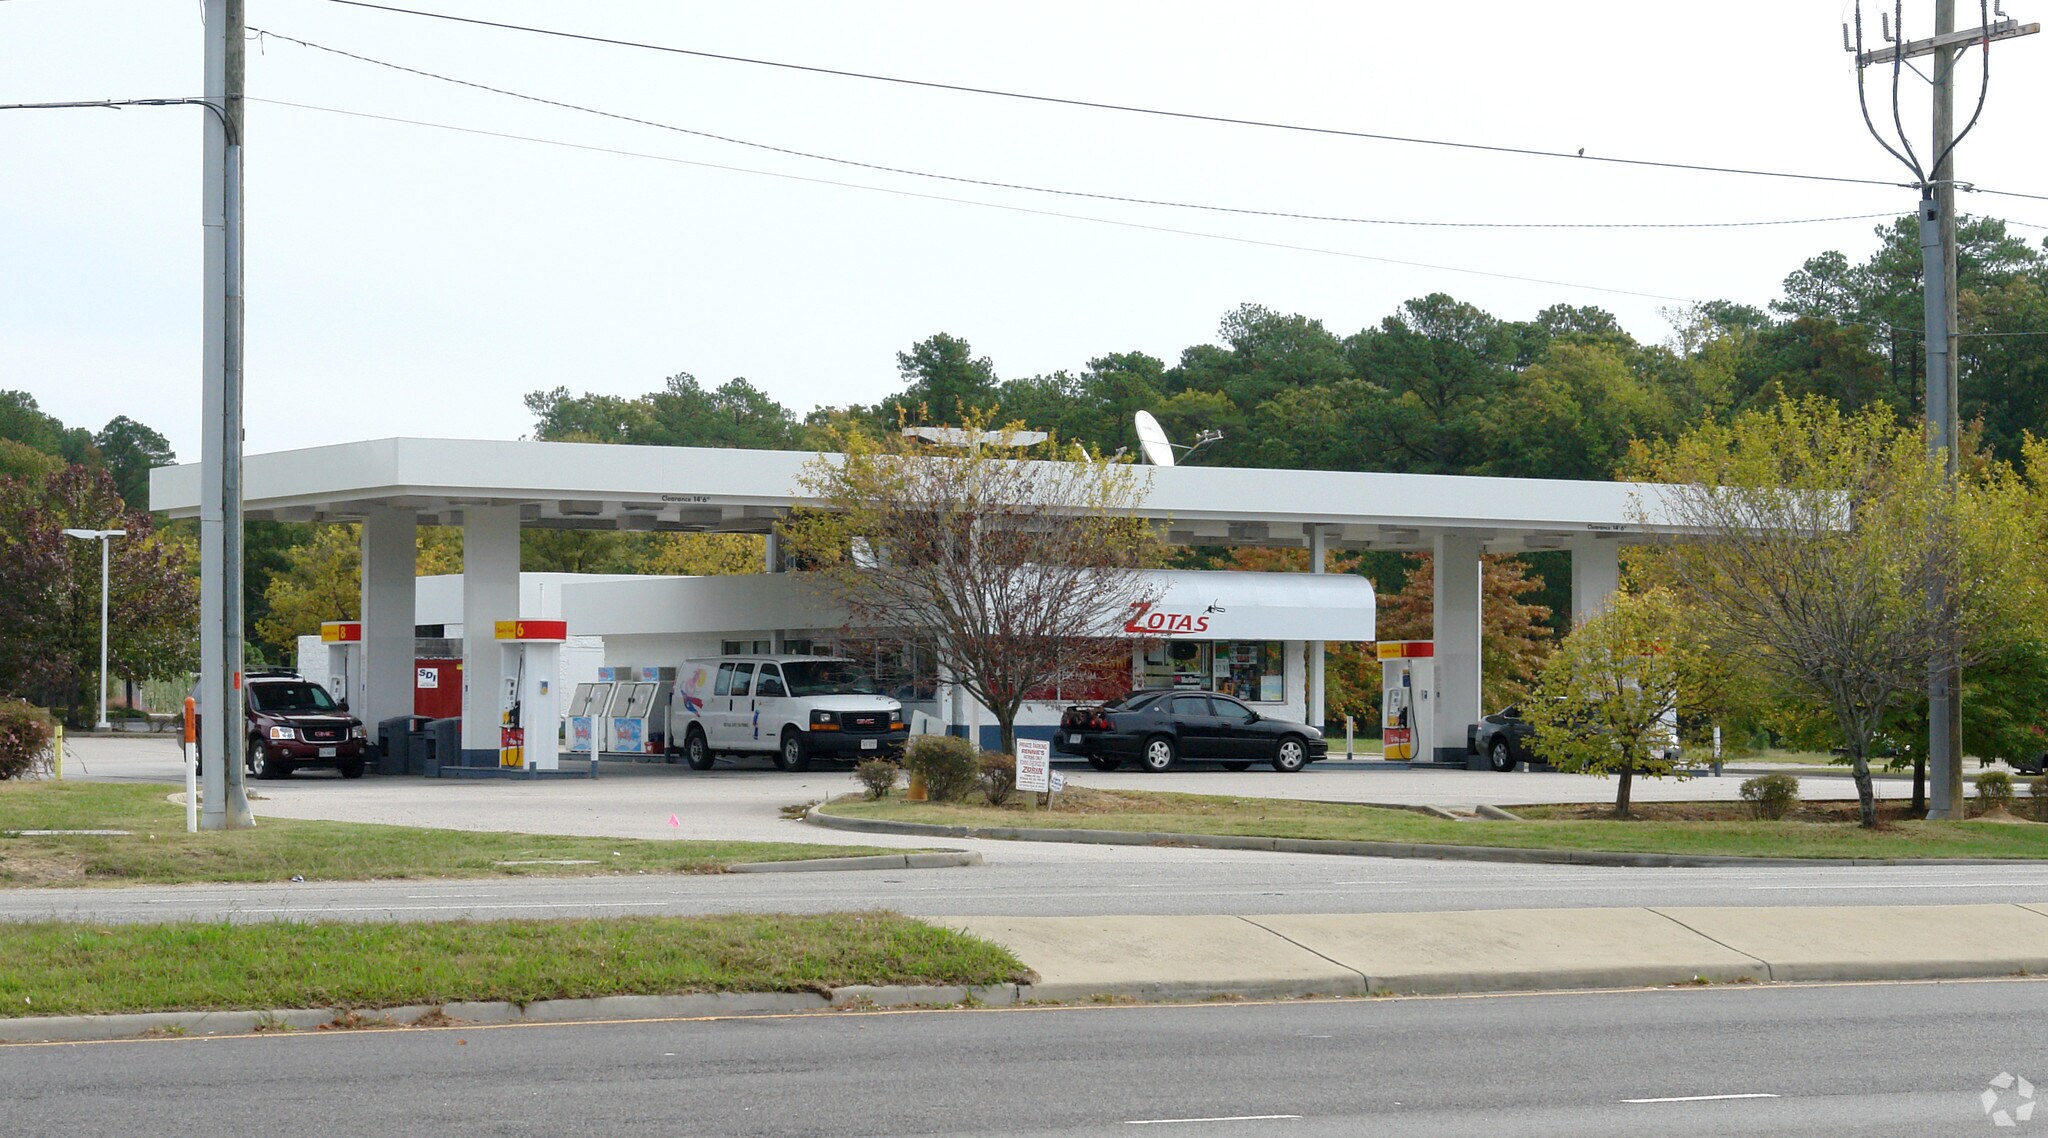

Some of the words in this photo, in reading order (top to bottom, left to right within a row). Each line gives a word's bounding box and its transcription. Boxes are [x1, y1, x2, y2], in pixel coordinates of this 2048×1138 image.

[1124, 602, 1210, 633] ZOTAS
[340, 626, 346, 639] 8
[516, 623, 524, 637] 6
[1402, 644, 1407, 656] 1
[418, 669, 436, 682] SDI
